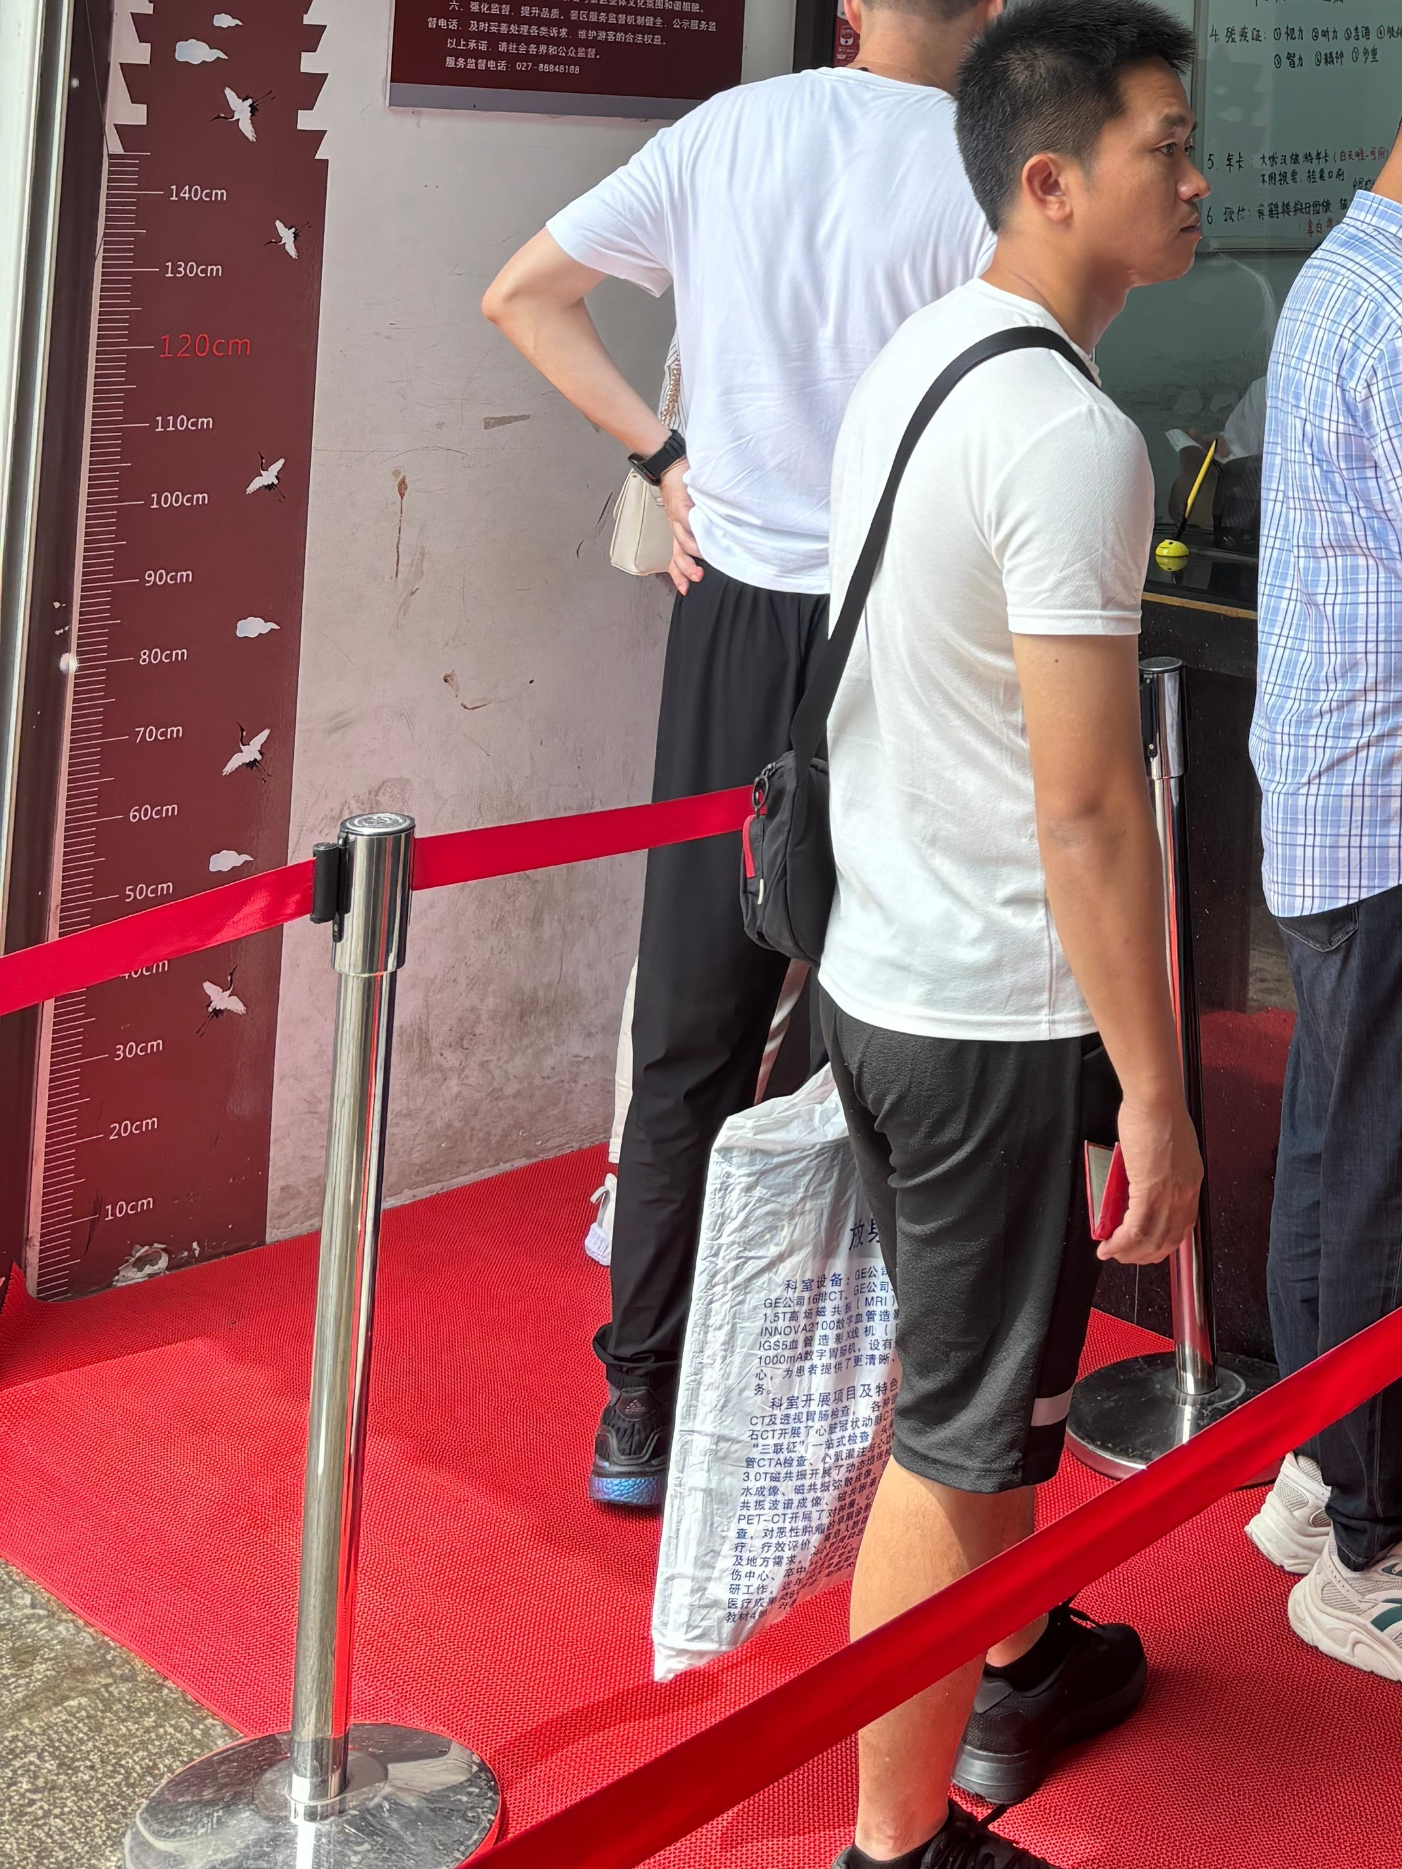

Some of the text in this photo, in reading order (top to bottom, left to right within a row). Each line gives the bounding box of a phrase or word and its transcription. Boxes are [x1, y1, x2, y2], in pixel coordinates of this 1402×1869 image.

[169, 184, 227, 204] 140cm
[164, 260, 223, 278] 130cm
[159, 334, 252, 359] 120cm
[155, 414, 213, 433] 110cm
[149, 490, 209, 509] 100cm
[144, 568, 193, 587] 90cm
[139, 646, 188, 665] 80cm
[134, 723, 183, 743] 70cm
[129, 801, 178, 822] 60cm
[125, 878, 174, 901] 50cm
[114, 1036, 163, 1060] 30cm
[109, 1114, 159, 1140] 20cm
[104, 1194, 154, 1222] 10cm
[753, 1382, 772, 1396] 务。
